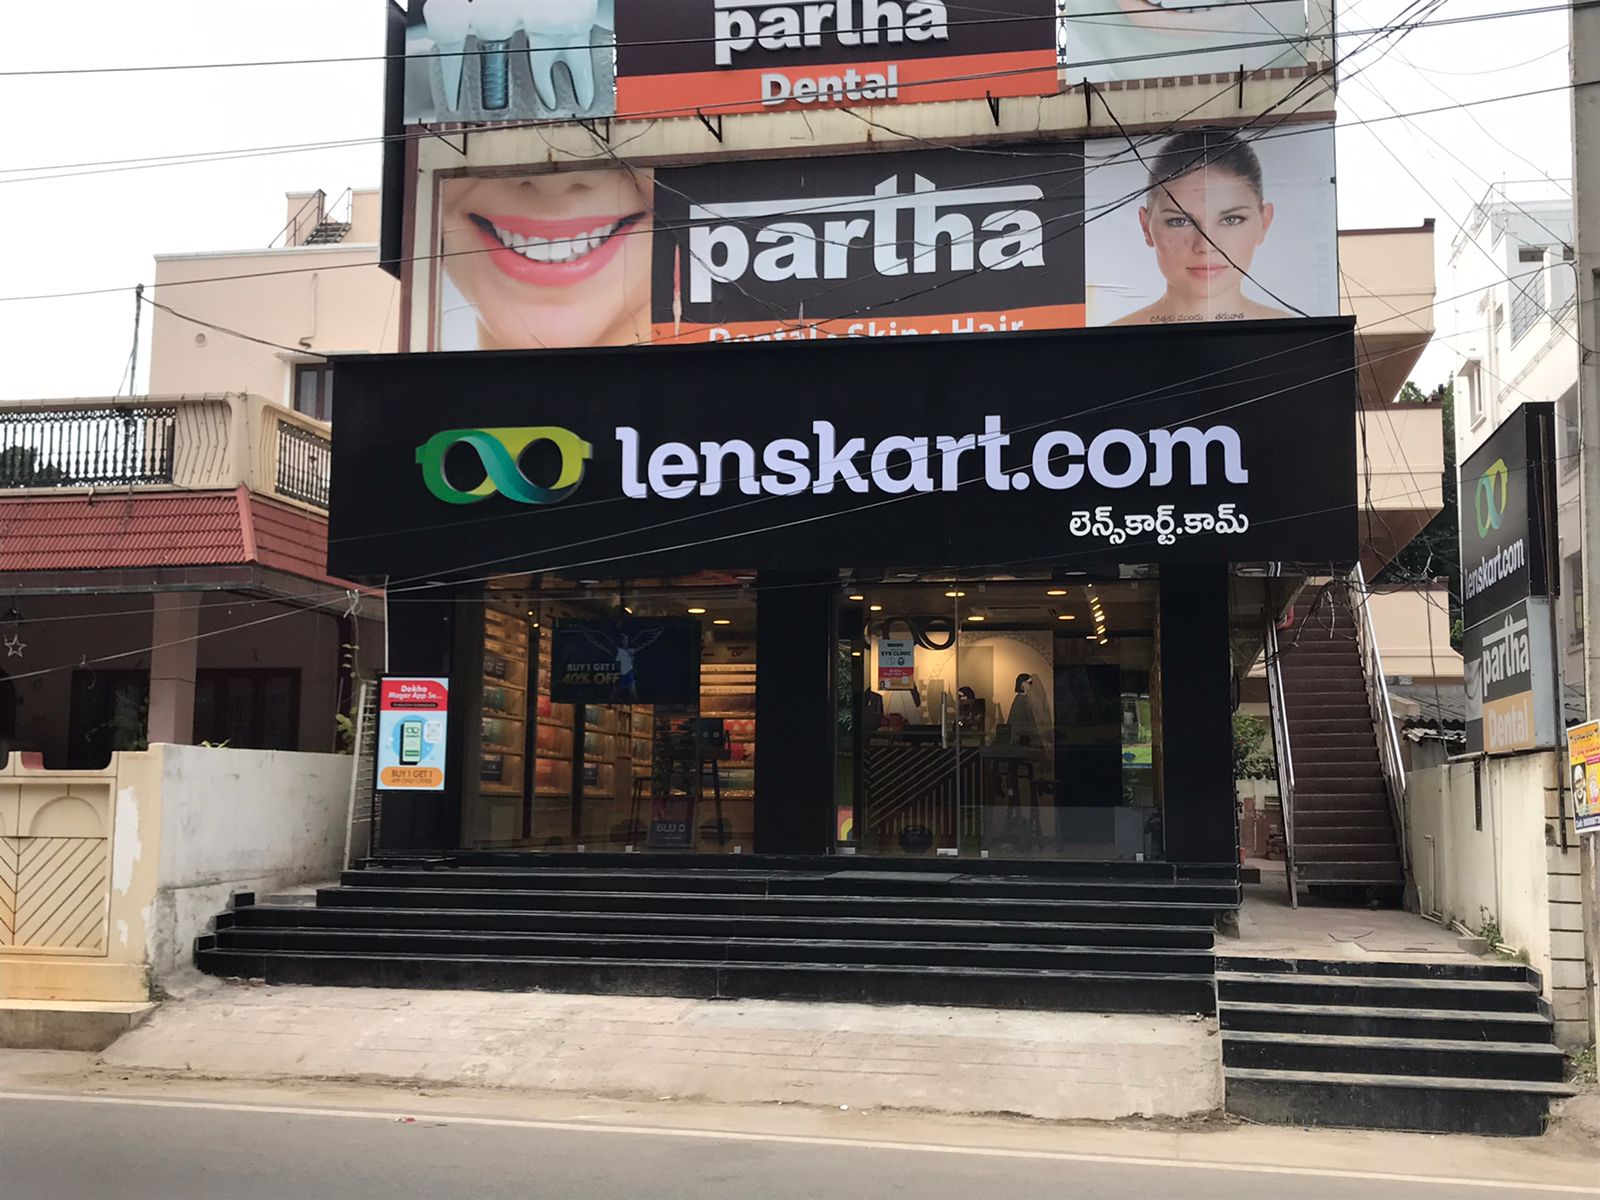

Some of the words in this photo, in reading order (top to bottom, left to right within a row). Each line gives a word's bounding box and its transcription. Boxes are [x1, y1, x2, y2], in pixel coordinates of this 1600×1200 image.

[714, 0, 949, 66] partha
[761, 64, 899, 105] Dental
[689, 173, 1046, 303] partha
[615, 415, 1249, 500] lenskart.com
[1465, 538, 1525, 600] lenskart.com
[594, 672, 620, 685] OFF
[1482, 613, 1531, 698] partha
[1487, 699, 1529, 747] Dental
[391, 769, 406, 778] BUY
